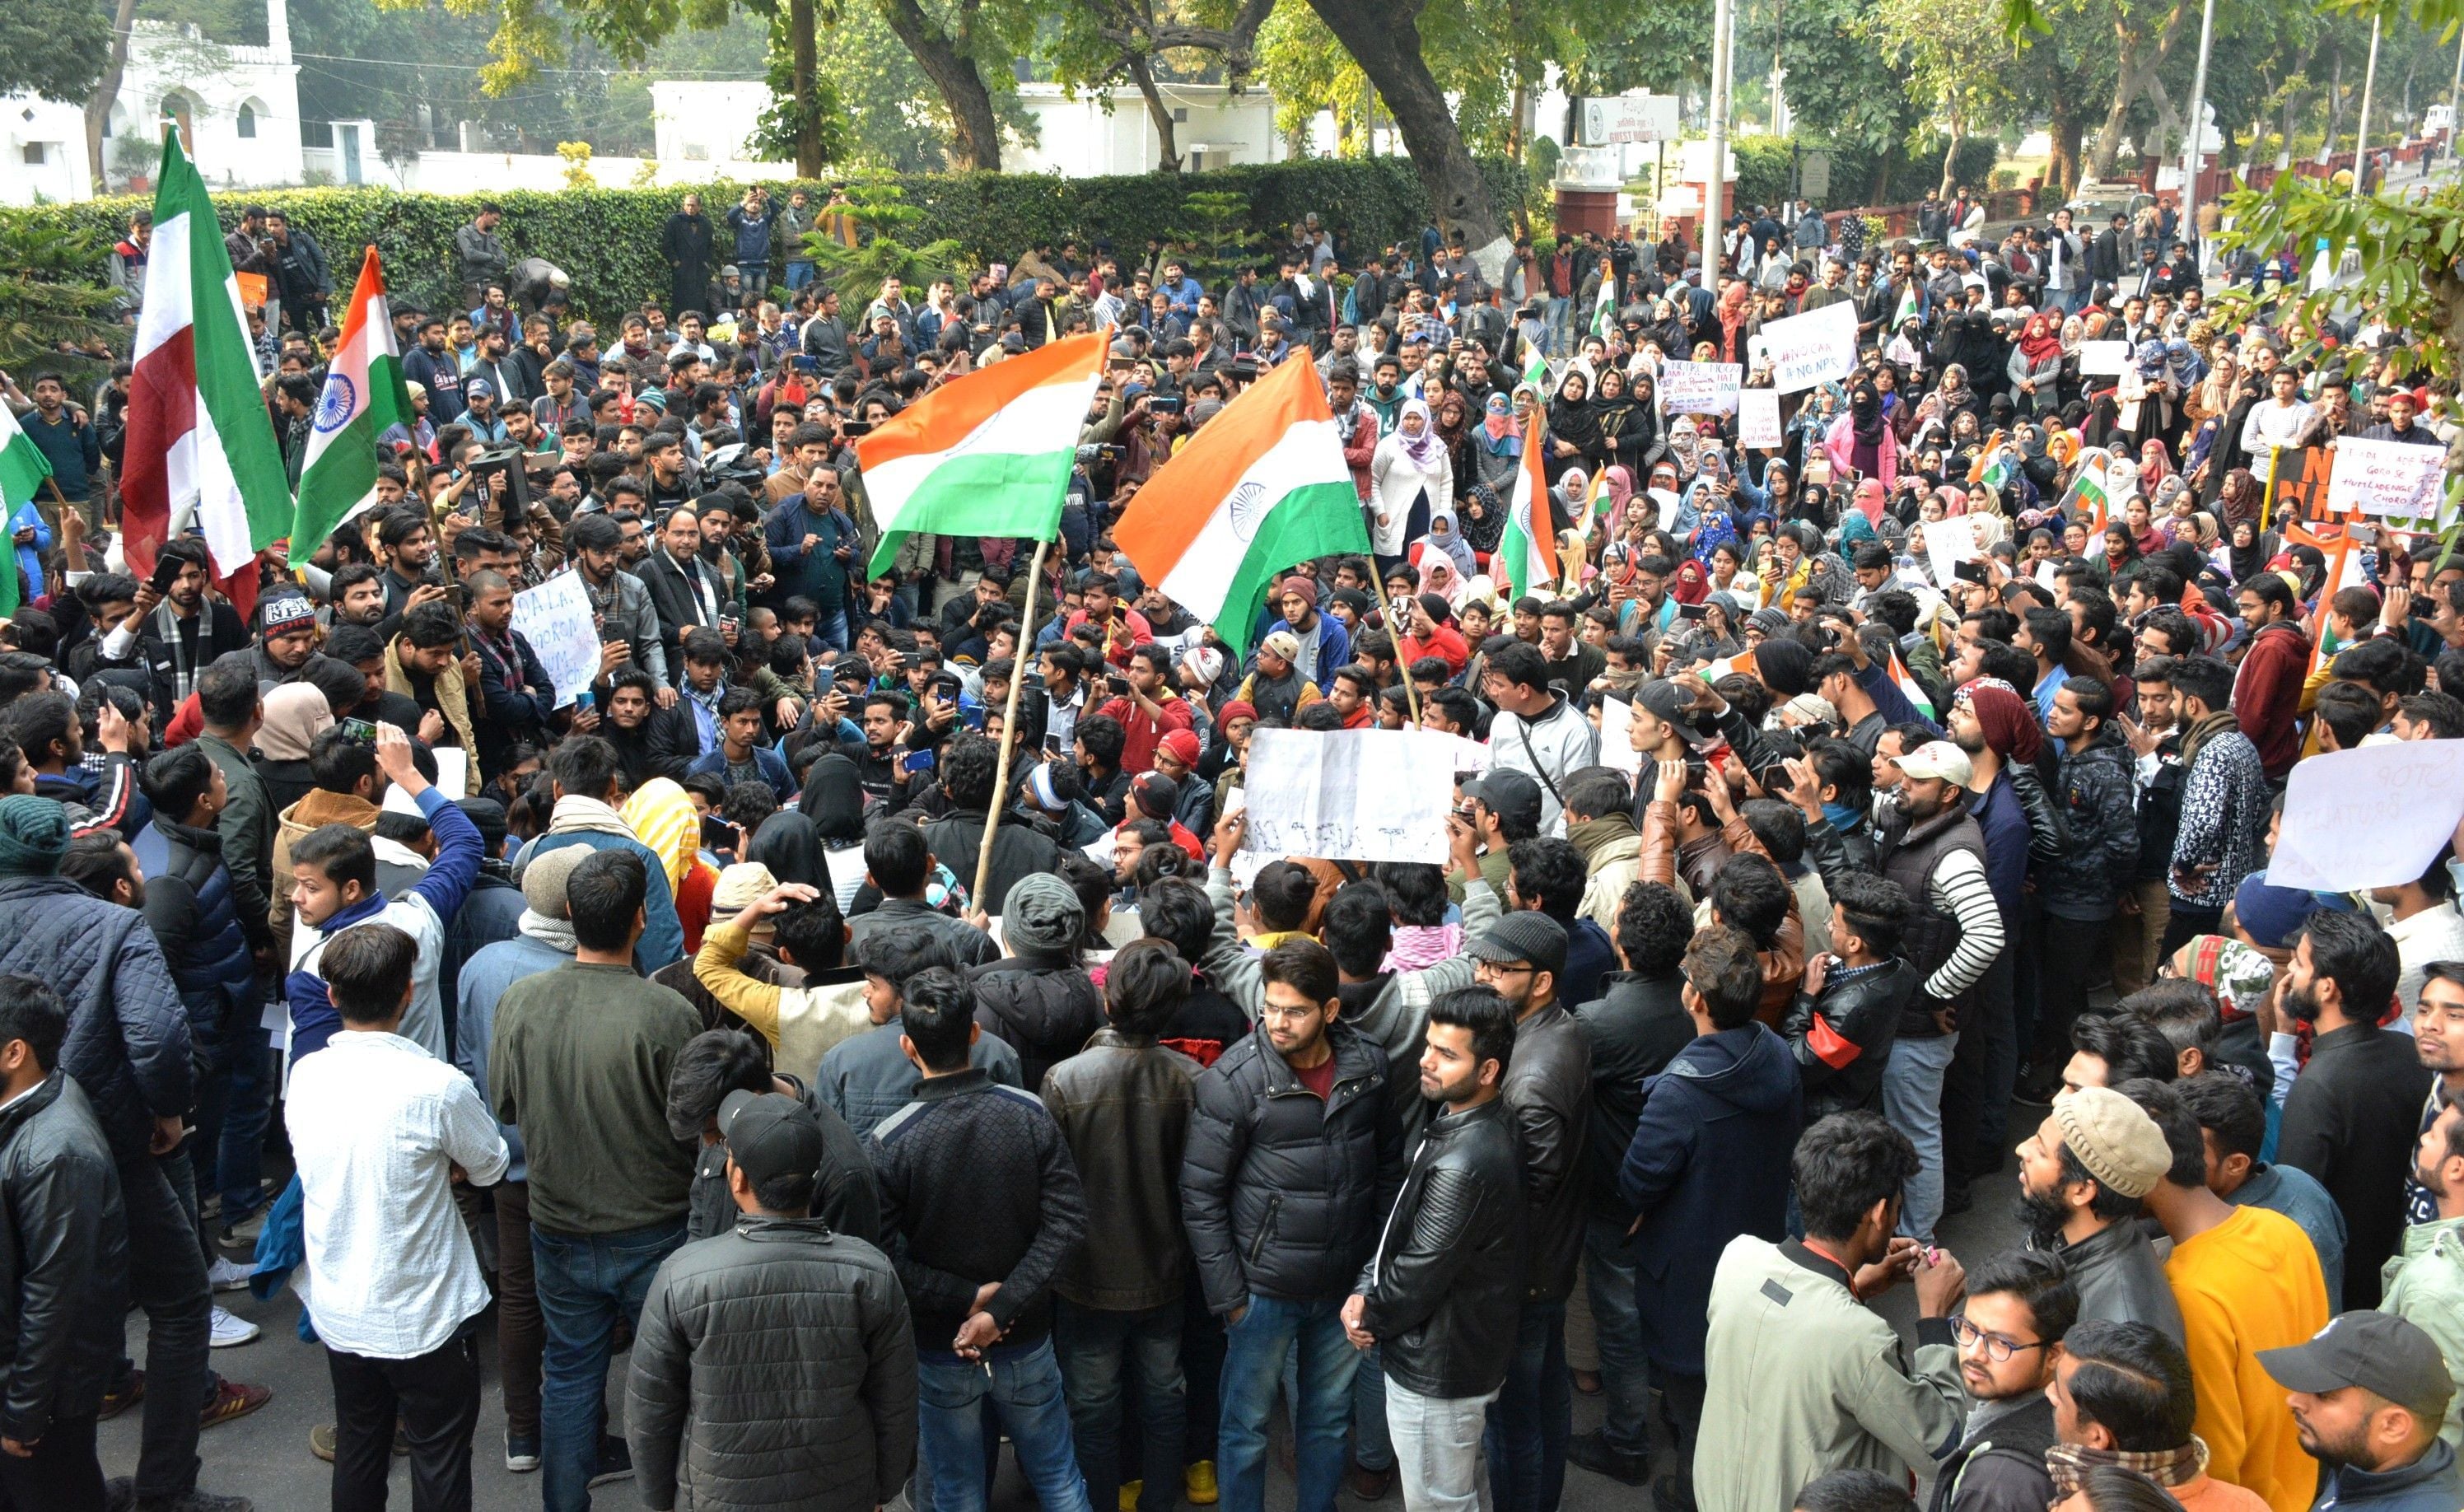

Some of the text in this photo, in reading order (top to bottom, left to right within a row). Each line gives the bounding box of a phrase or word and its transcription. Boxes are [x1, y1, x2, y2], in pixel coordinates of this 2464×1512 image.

[1609, 131, 1631, 142] GUEST
[2373, 494, 2407, 506] CHORO
[271, 604, 310, 620] NFL
